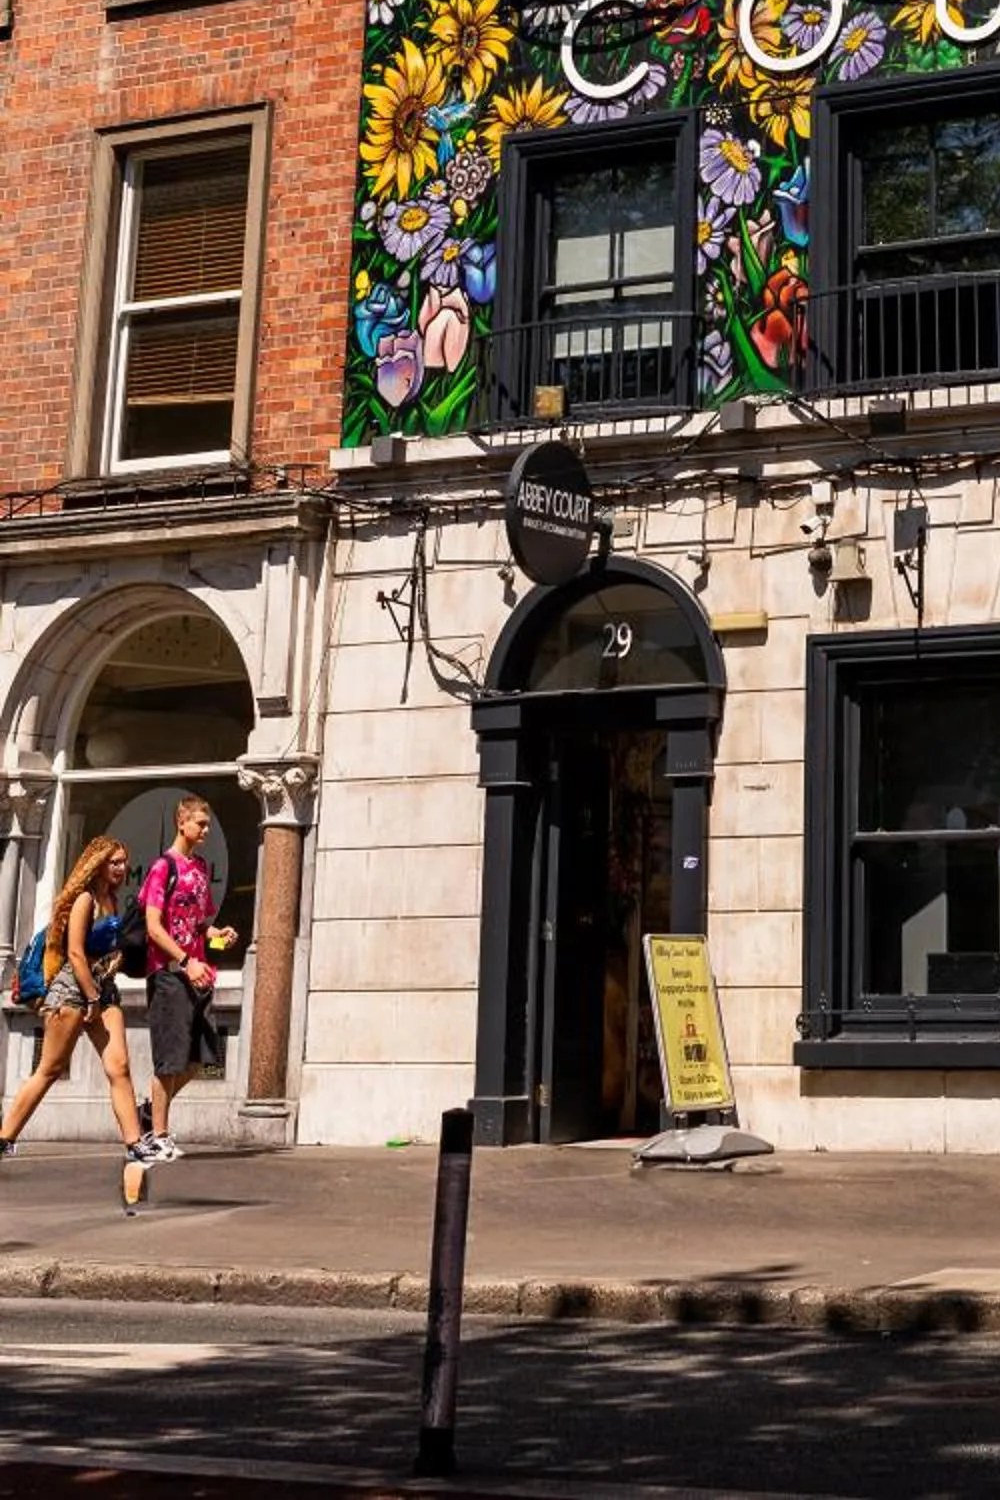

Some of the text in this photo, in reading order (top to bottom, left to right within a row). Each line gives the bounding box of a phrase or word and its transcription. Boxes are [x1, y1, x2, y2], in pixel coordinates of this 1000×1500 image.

[517, 481, 591, 525] ABBEY COURT
[601, 621, 633, 658] 29
